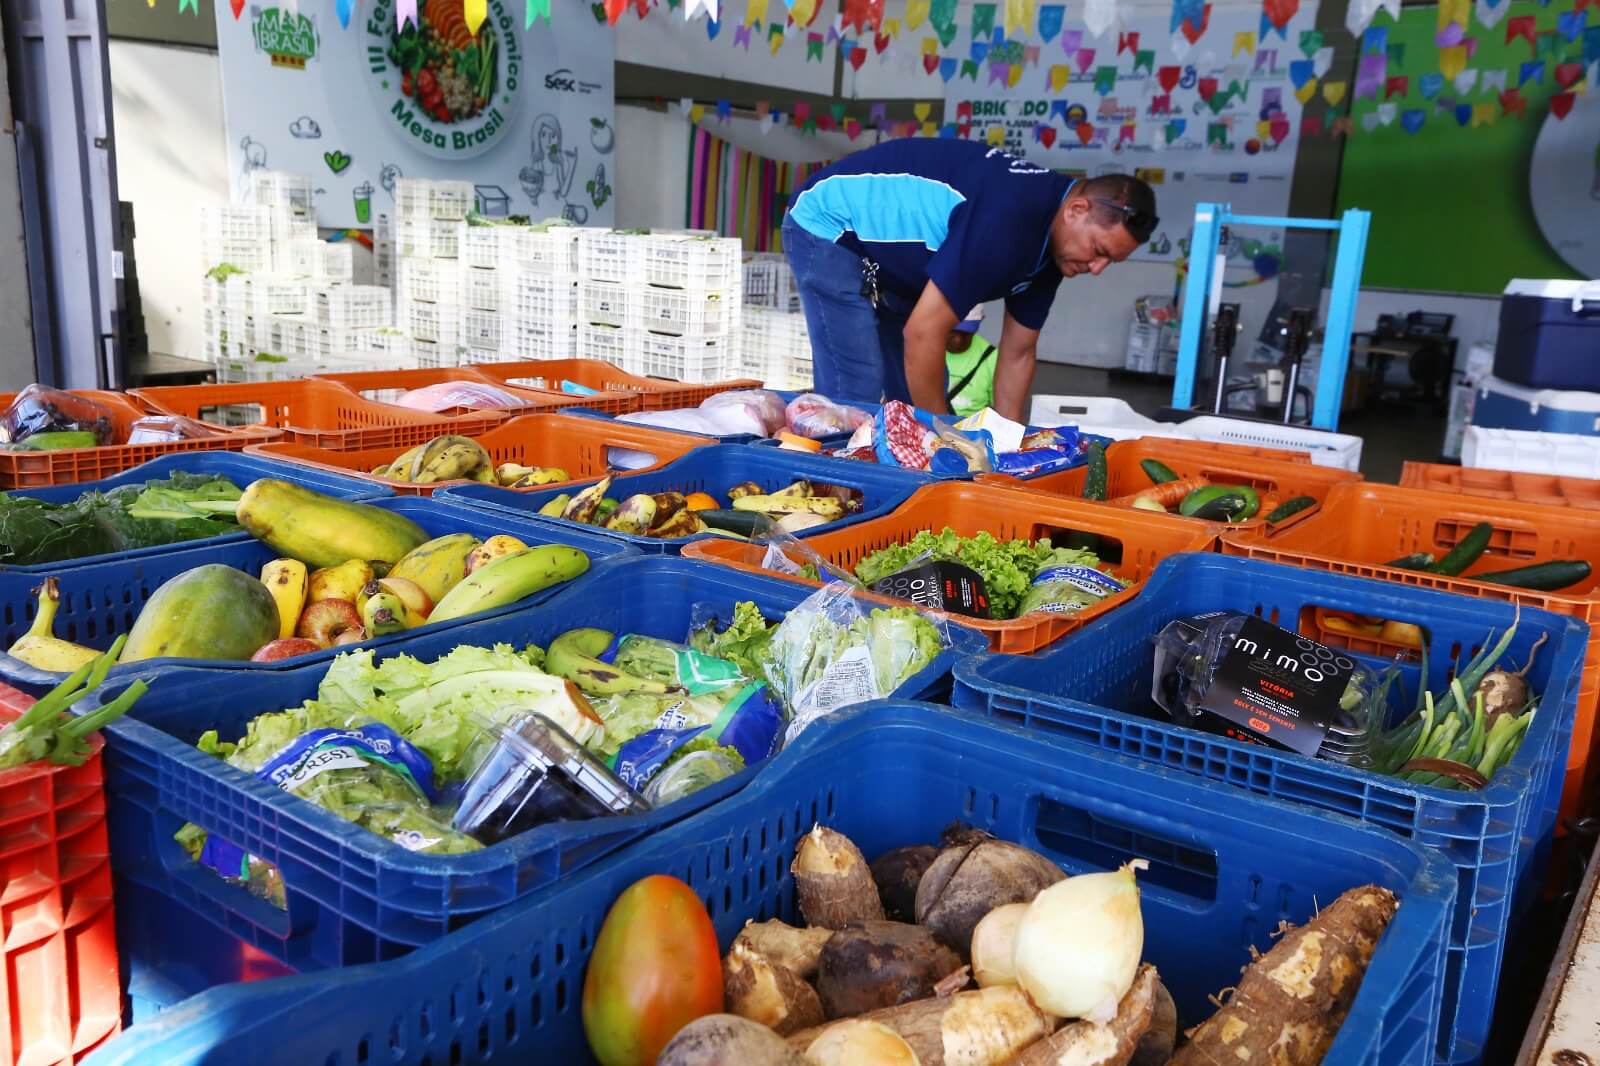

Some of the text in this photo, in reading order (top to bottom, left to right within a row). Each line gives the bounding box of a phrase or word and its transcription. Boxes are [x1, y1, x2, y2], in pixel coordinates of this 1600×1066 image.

[260, 29, 314, 56] BRASIL
[366, 0, 522, 91] III Fes nômico
[390, 98, 505, 150] Mesa Brasil
[964, 100, 1049, 117] BRIDO
[911, 579, 927, 603] mo
[1234, 638, 1324, 682] mimo
